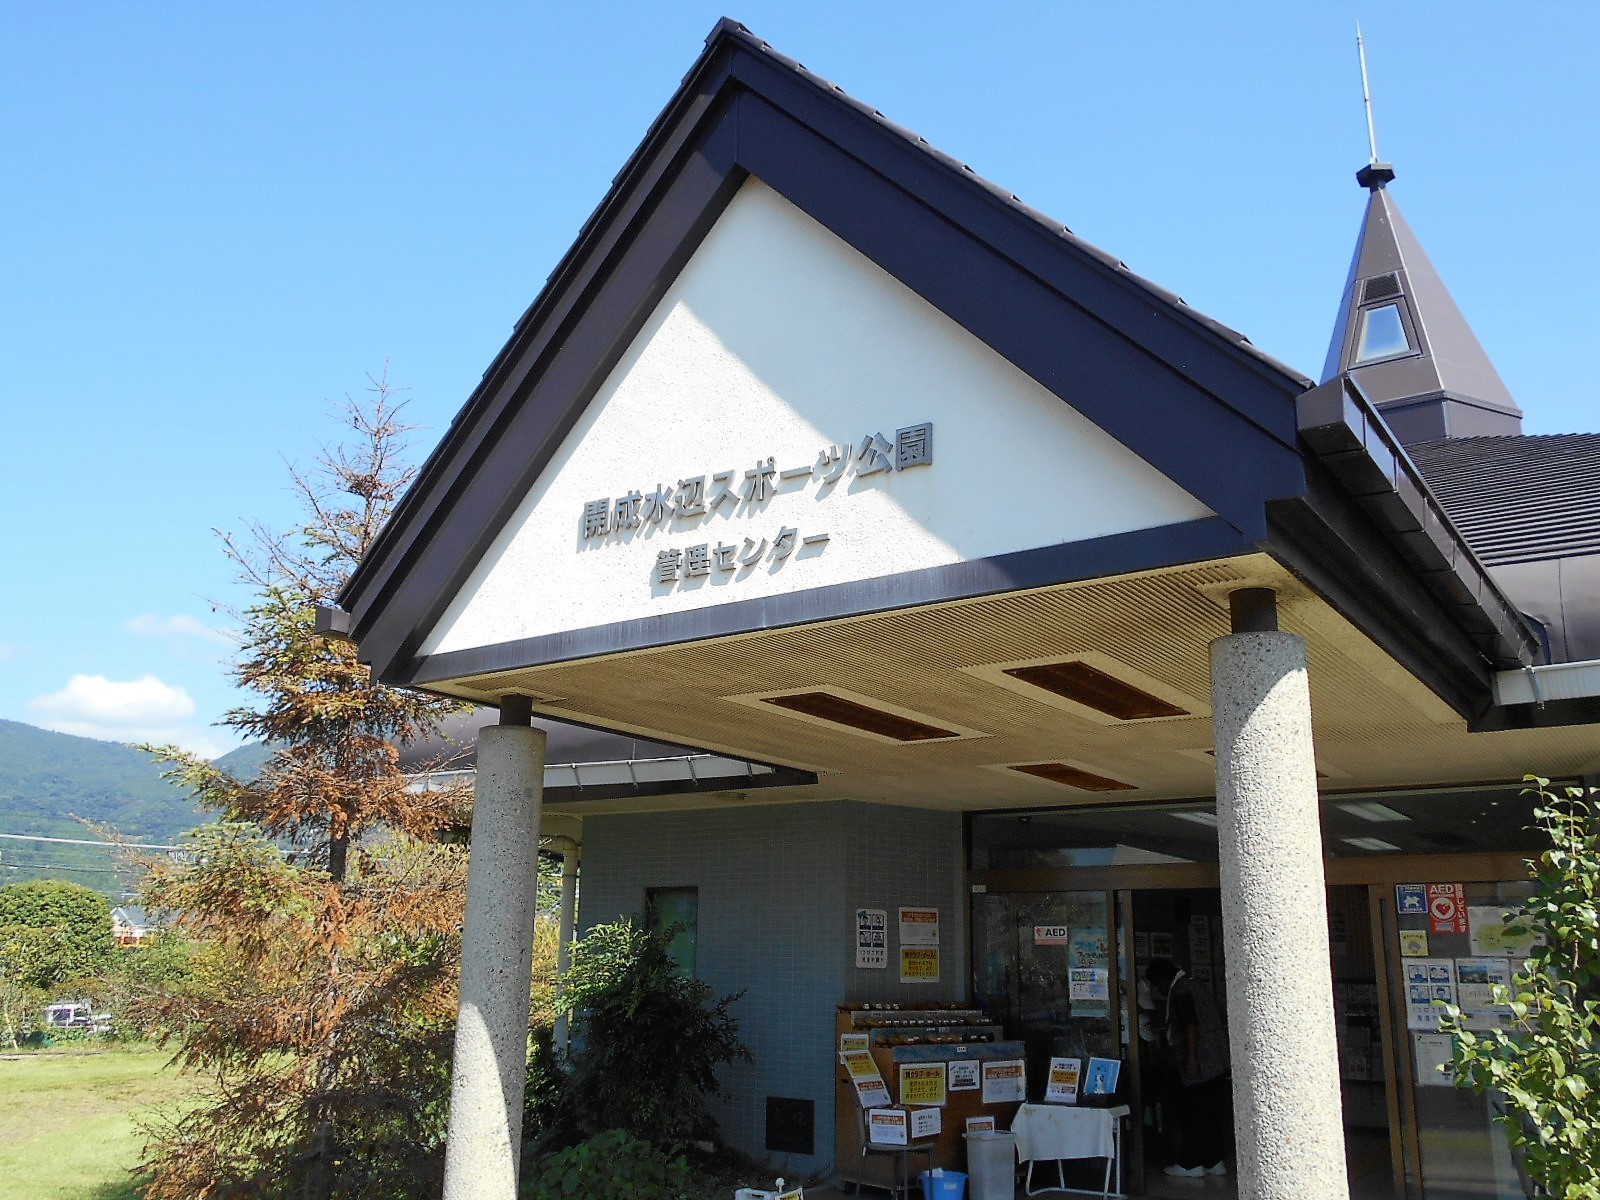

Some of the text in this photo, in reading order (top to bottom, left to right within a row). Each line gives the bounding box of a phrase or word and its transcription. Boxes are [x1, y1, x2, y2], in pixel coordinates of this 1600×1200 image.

[584, 422, 933, 538] 開成水辺スポーツ公園
[656, 526, 831, 584] 管理センター
[1430, 884, 1454, 893] AED
[1045, 928, 1066, 937] AED
